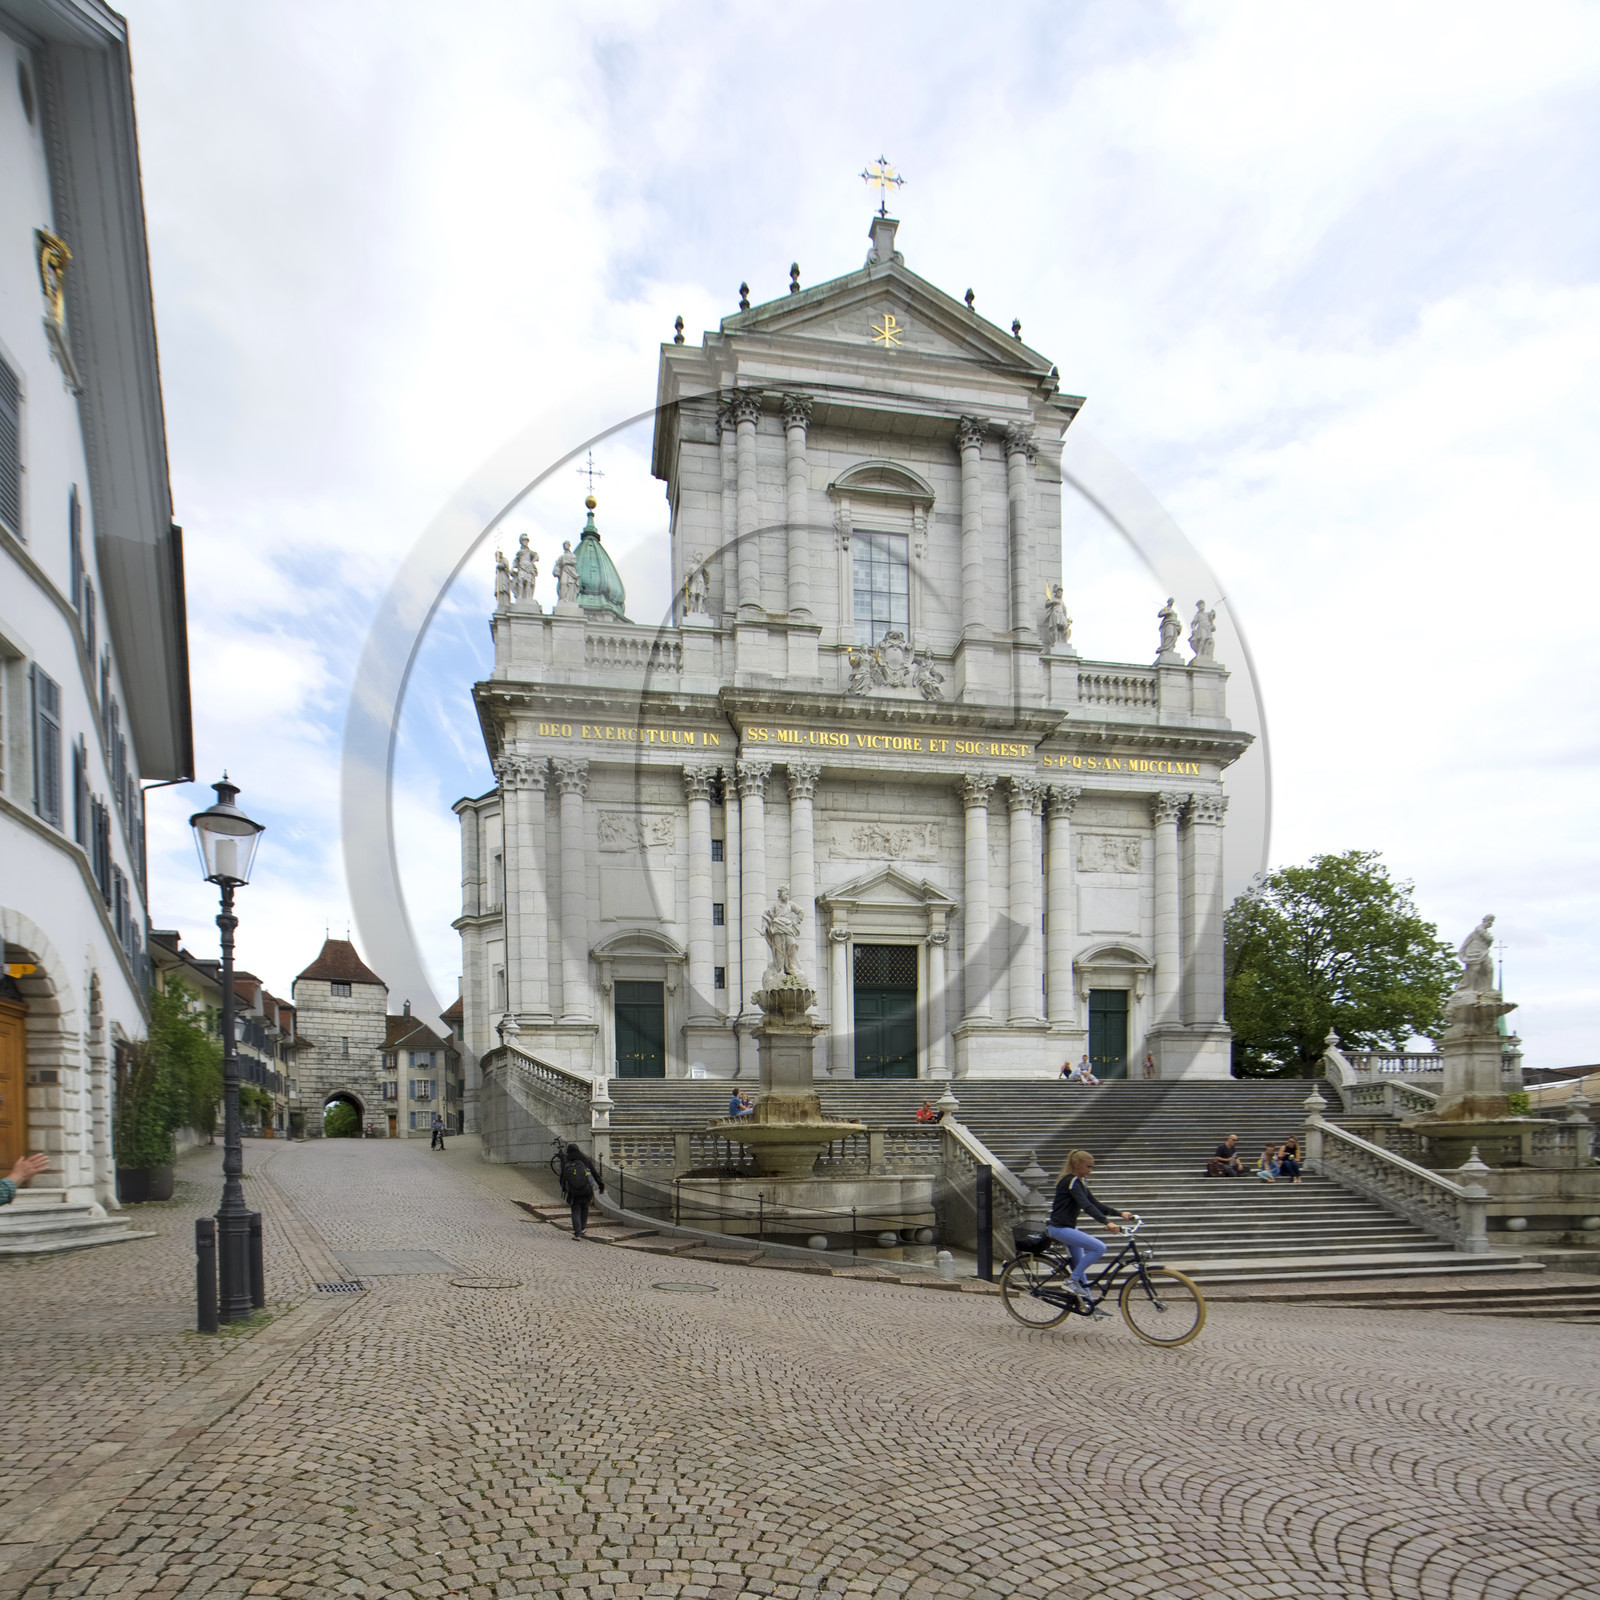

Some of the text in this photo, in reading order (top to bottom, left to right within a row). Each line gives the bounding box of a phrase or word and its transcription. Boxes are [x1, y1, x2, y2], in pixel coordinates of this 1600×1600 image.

[538, 722, 720, 746] DEO EXERCITUUM IN
[856, 734, 922, 751] VICTORE
[929, 738, 949, 753] ET
